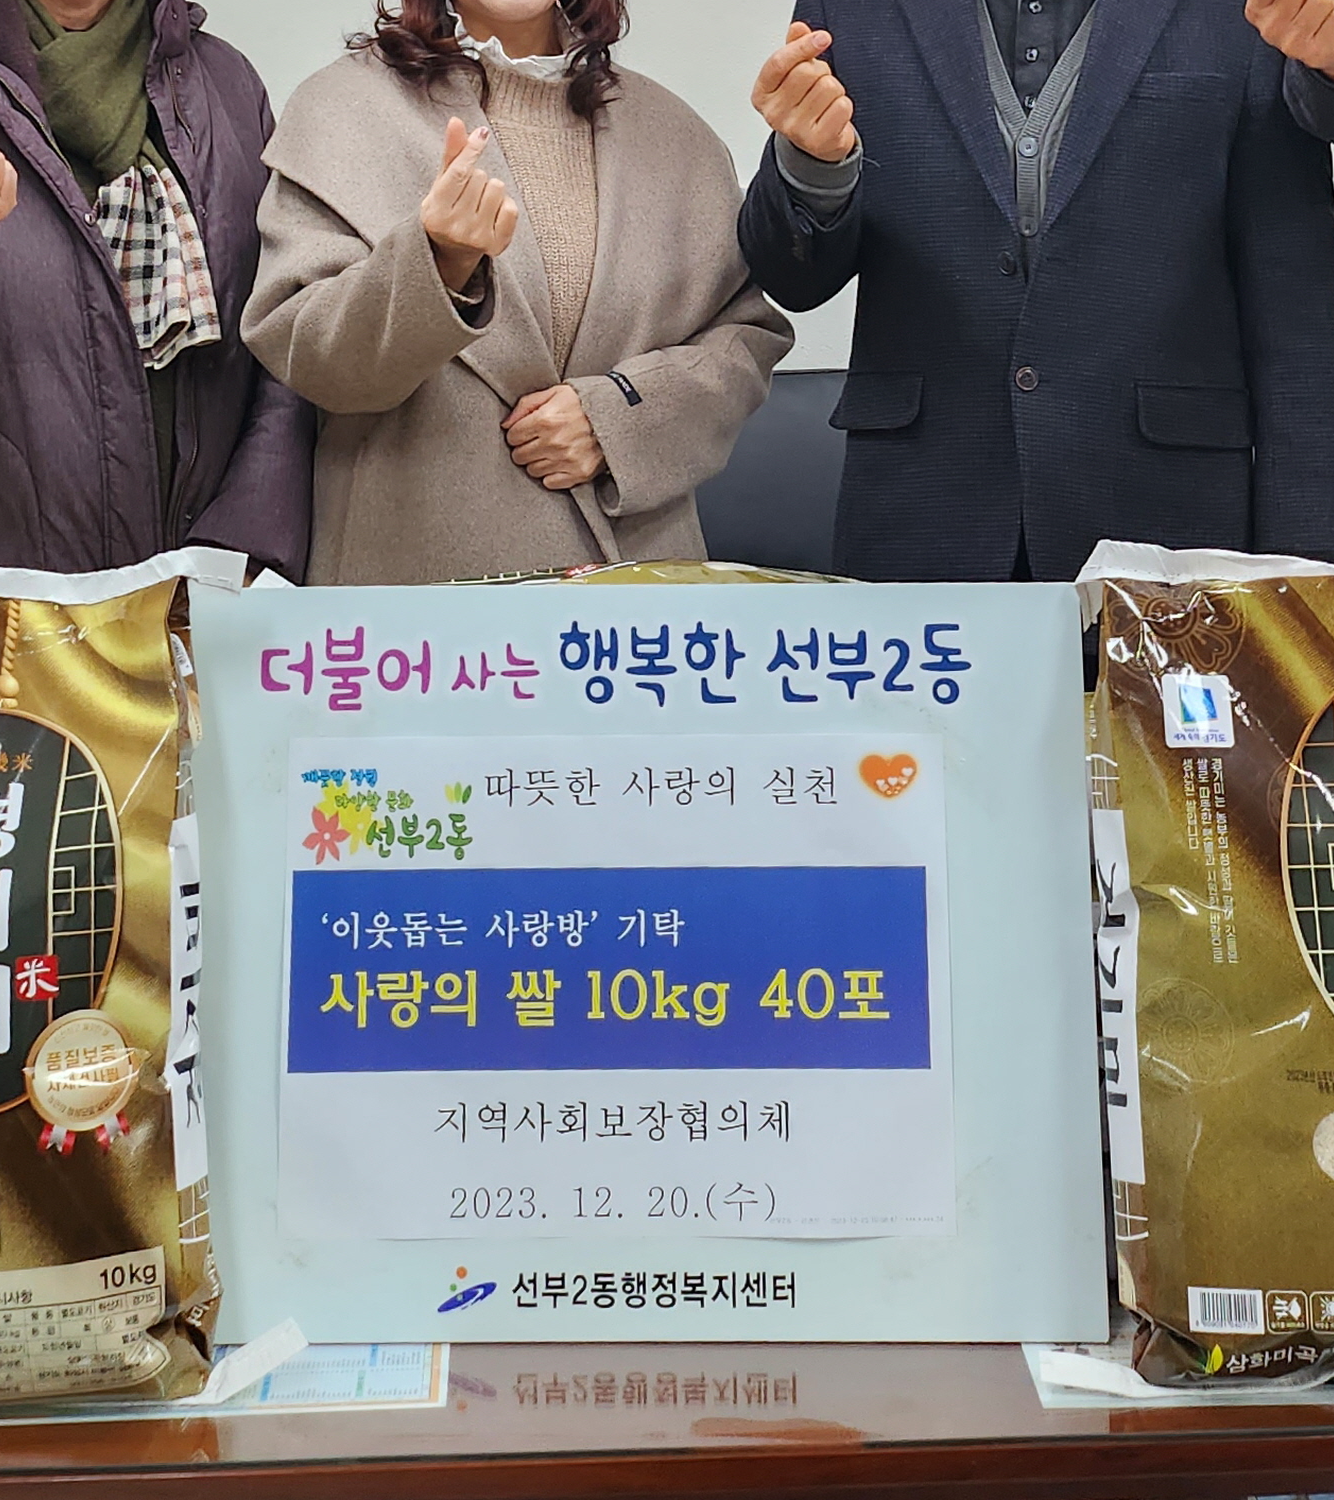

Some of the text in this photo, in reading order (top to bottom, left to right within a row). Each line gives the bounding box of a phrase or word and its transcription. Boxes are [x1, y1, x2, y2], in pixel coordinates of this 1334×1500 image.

[259, 618, 972, 712] 더불어 사는 행복한 선부2동
[334, 790, 414, 813] 다양한 문화
[485, 765, 838, 808] 따뜻한 사랑의 실천
[365, 813, 474, 861] 선부2동
[320, 908, 685, 951] ‘이웃돕는 사랑방’ 기탁
[16, 955, 60, 999] 米
[320, 967, 891, 1029] 사랑의 쌀 10kg 40포
[47, 1043, 116, 1072] 품질보증
[433, 1099, 793, 1145] 지역사회보장협의체
[449, 1185, 547, 1222] 2023.
[572, 1184, 624, 1222] 12.
[511, 1271, 798, 1312] 선부2동행정복지센터
